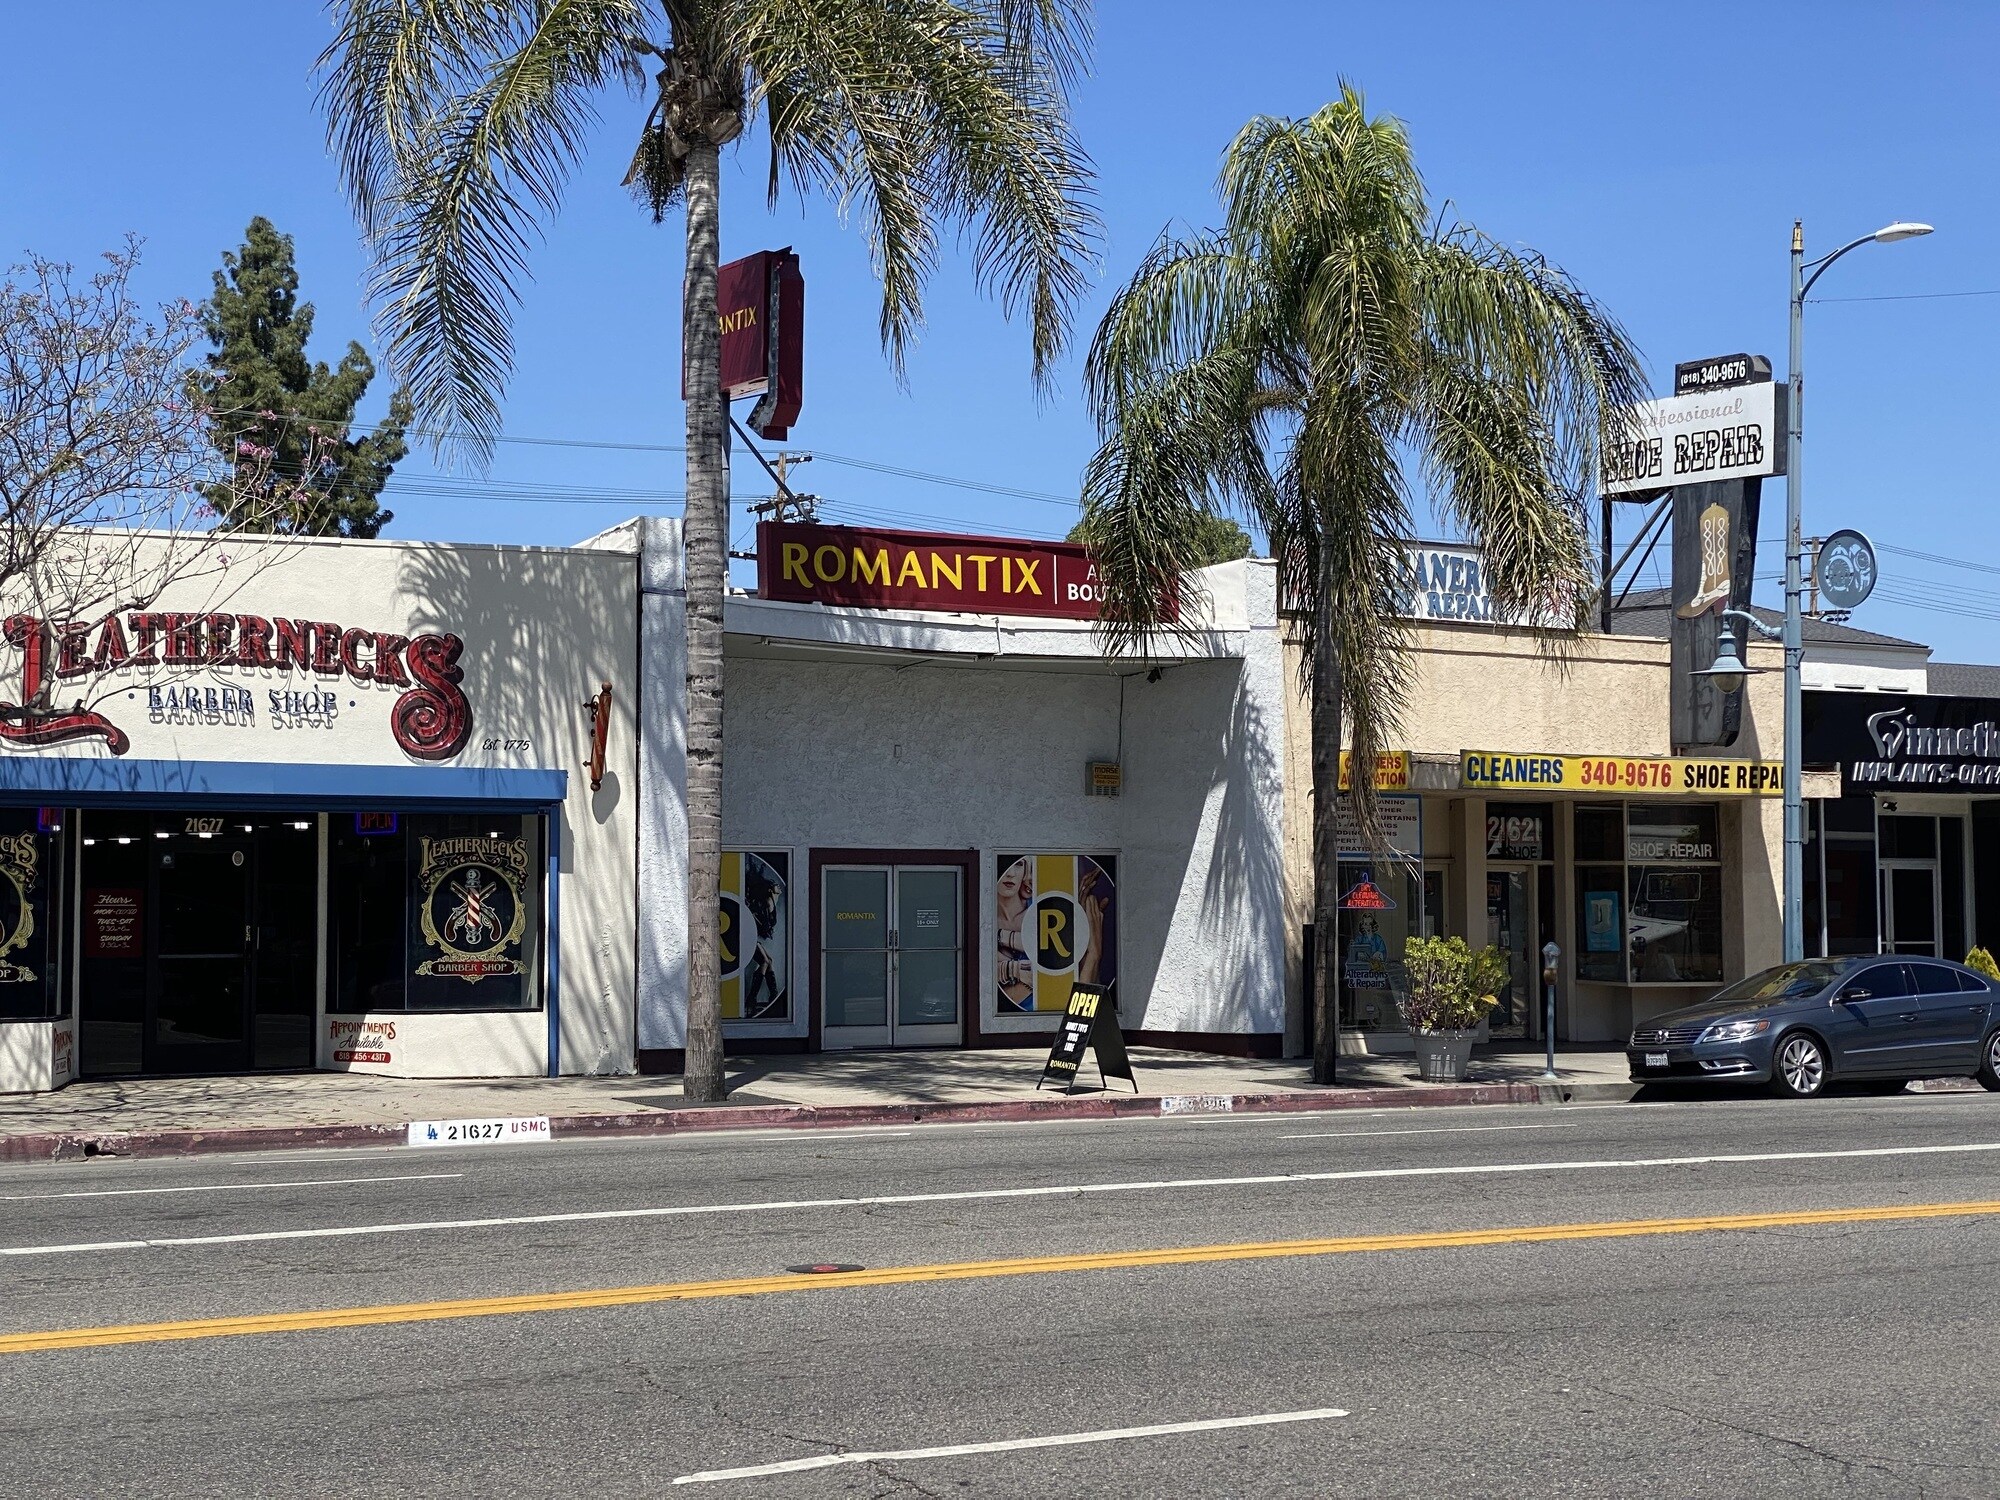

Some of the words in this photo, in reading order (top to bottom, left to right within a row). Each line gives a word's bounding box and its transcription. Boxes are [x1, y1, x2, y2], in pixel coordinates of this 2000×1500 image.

[1680, 373, 1700, 387] (818)
[1701, 361, 1746, 384] 340-9676
[1674, 423, 1764, 474] REPAIR
[782, 542, 1043, 596] ROMANTIX
[0, 612, 473, 759] LEATHERNECKS
[147, 685, 254, 715] BARBER
[268, 687, 337, 715] SHOP
[503, 739, 531, 751] 1775
[1467, 756, 1564, 784] CLEANERS
[1581, 761, 1672, 788] 340-9676
[1684, 764, 1729, 789] SHOE
[185, 817, 224, 832] 21627
[419, 835, 529, 872] LEATHERNECKS
[1629, 842, 1664, 856] SHOE
[1669, 843, 1712, 858] REPAIR
[97, 894, 133, 904] Hours
[836, 912, 876, 920] ROMANTIX
[1039, 908, 1071, 958] R
[438, 963, 477, 972] BARBER
[481, 963, 507, 972] SHOP
[1346, 970, 1389, 979] Alterations
[1357, 979, 1386, 990] Repairs
[1068, 991, 1100, 1018] OPEN
[330, 1020, 397, 1040] APPOINTMENTS
[339, 1034, 385, 1050] Available
[1049, 1059, 1077, 1071] ROMANTIX
[448, 1124, 503, 1140] 21627
[511, 1120, 547, 1134] USMC
